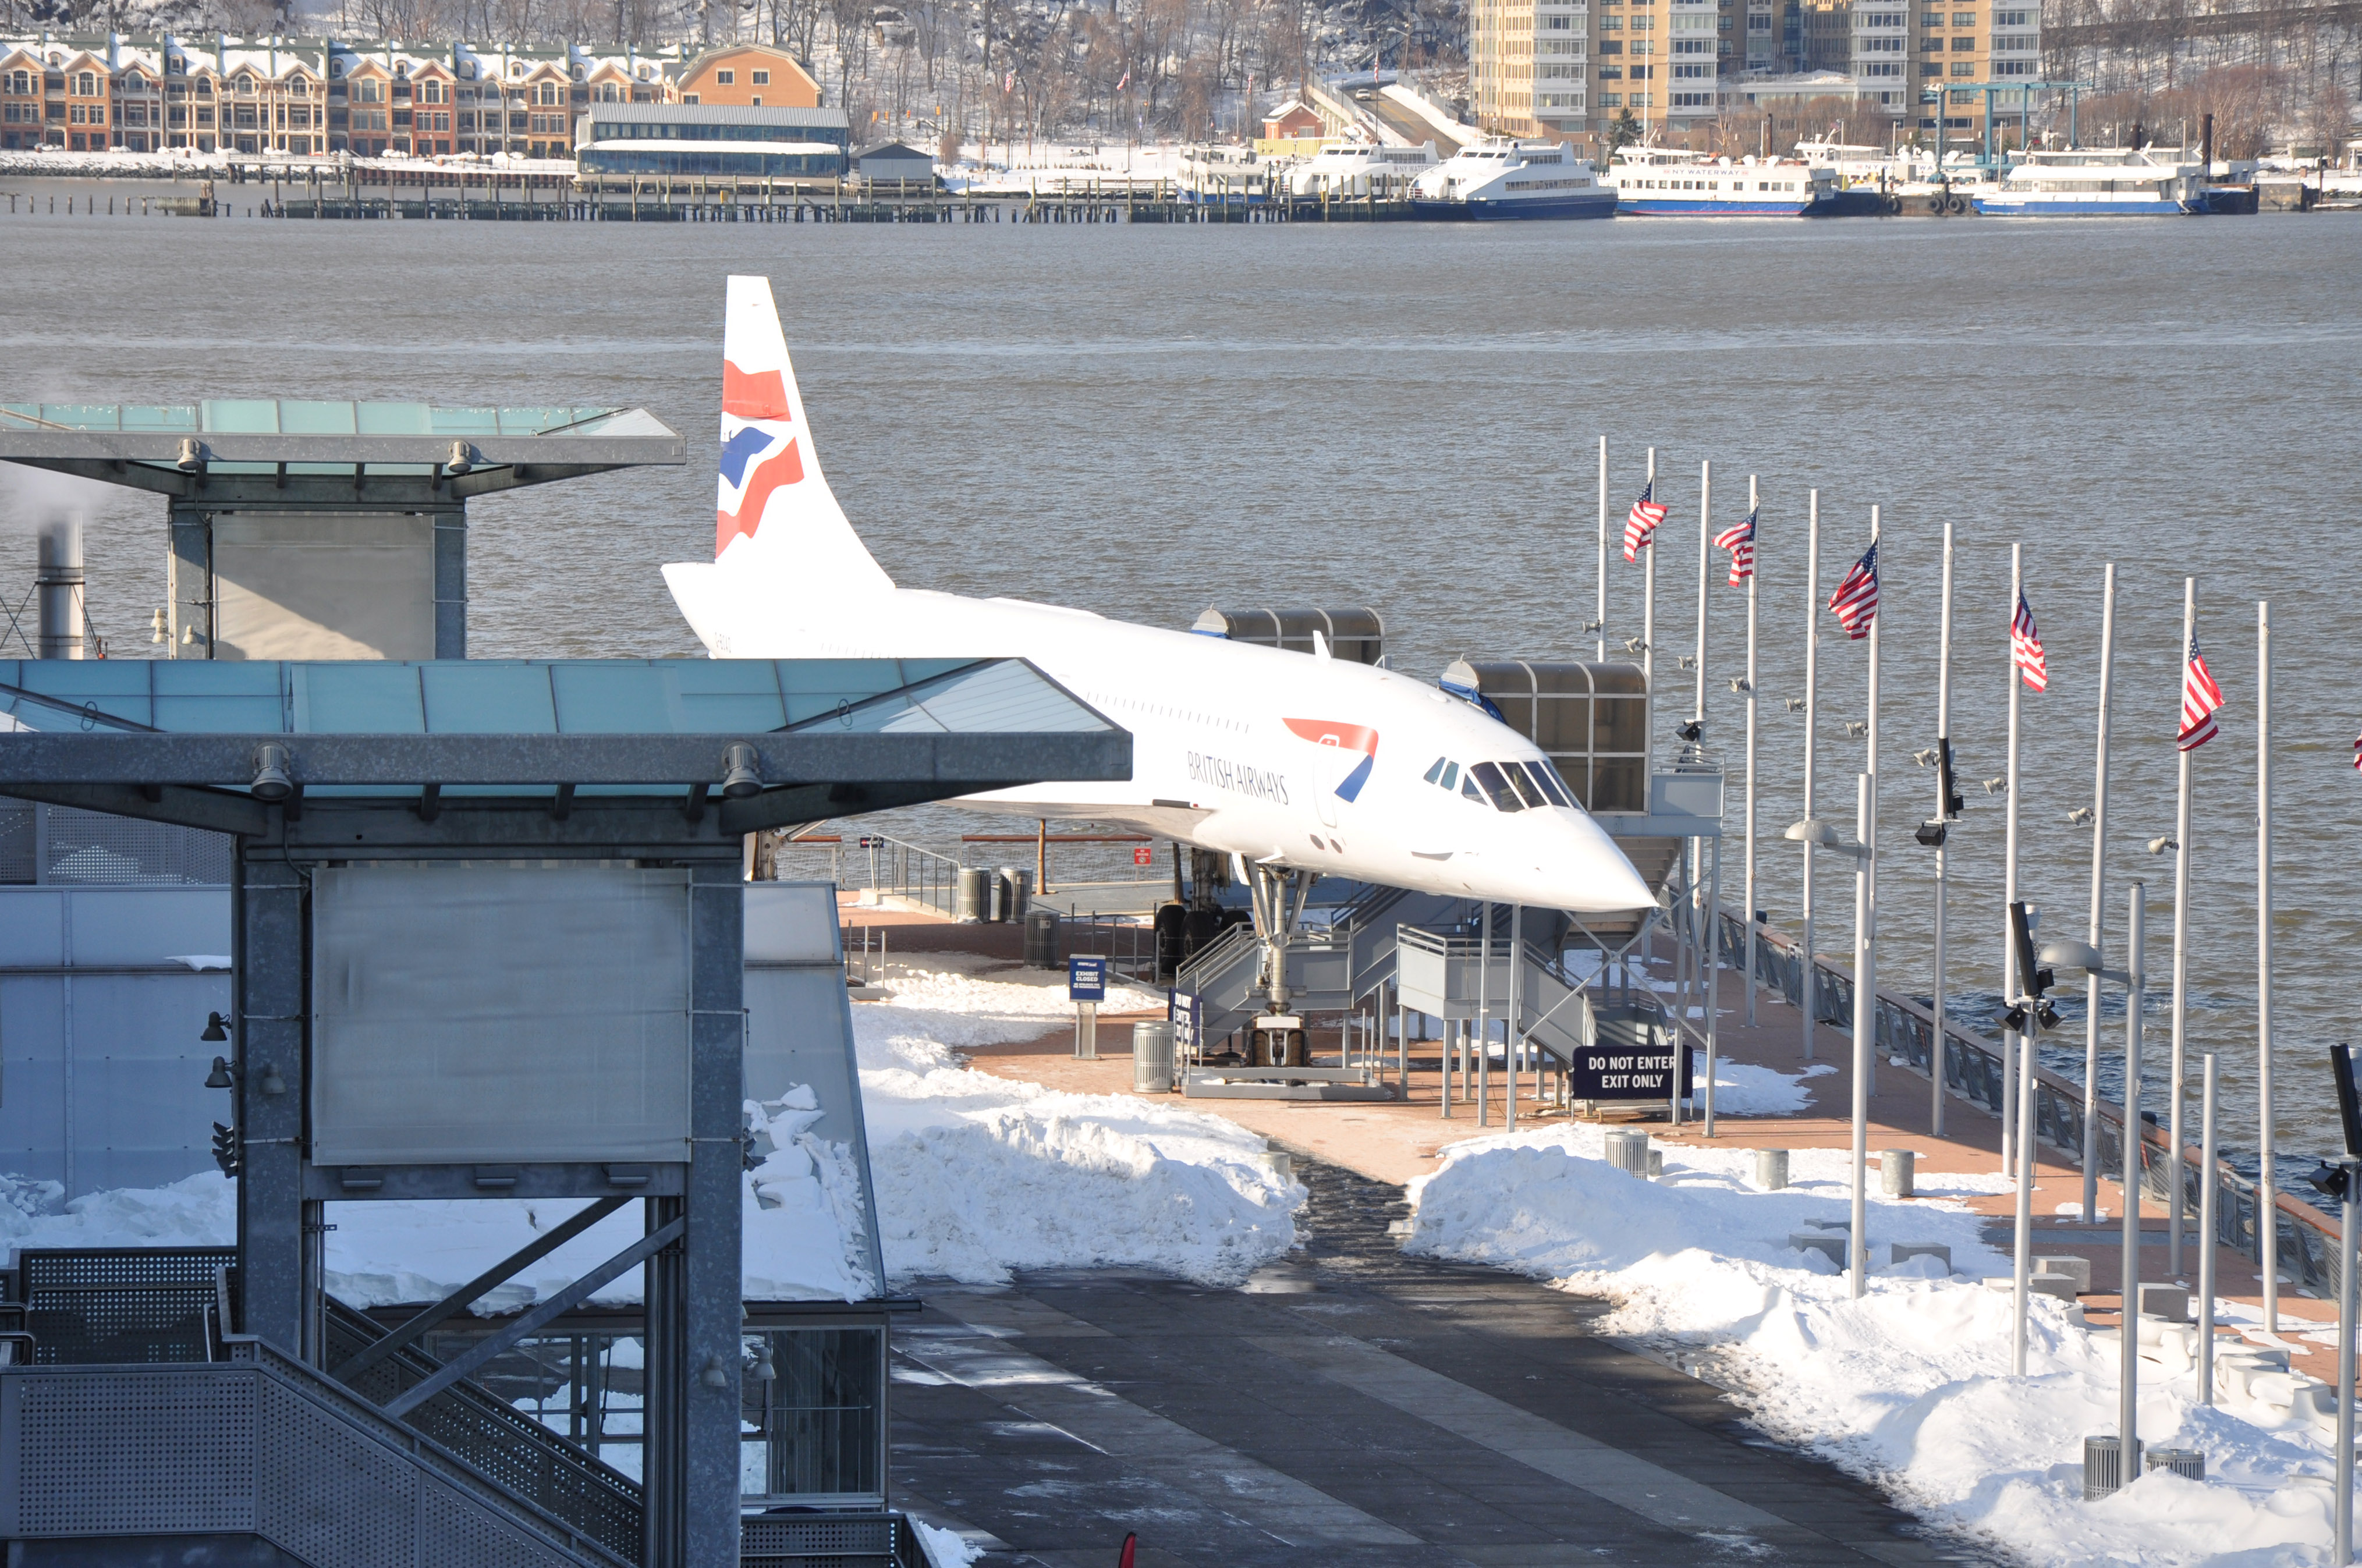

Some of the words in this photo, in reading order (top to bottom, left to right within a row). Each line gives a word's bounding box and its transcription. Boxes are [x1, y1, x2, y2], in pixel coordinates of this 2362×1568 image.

[1188, 751, 1235, 791] BRITISH
[1237, 764, 1288, 806] AIRWAYS
[1175, 992, 1182, 1006] DO
[1182, 995, 1192, 1009] NOT
[1588, 1057, 1606, 1070] DO
[1609, 1057, 1634, 1070] NOT
[1637, 1056, 1675, 1069] ENTER
[1602, 1075, 1629, 1088] EXIT
[1632, 1074, 1664, 1088] ONLY
